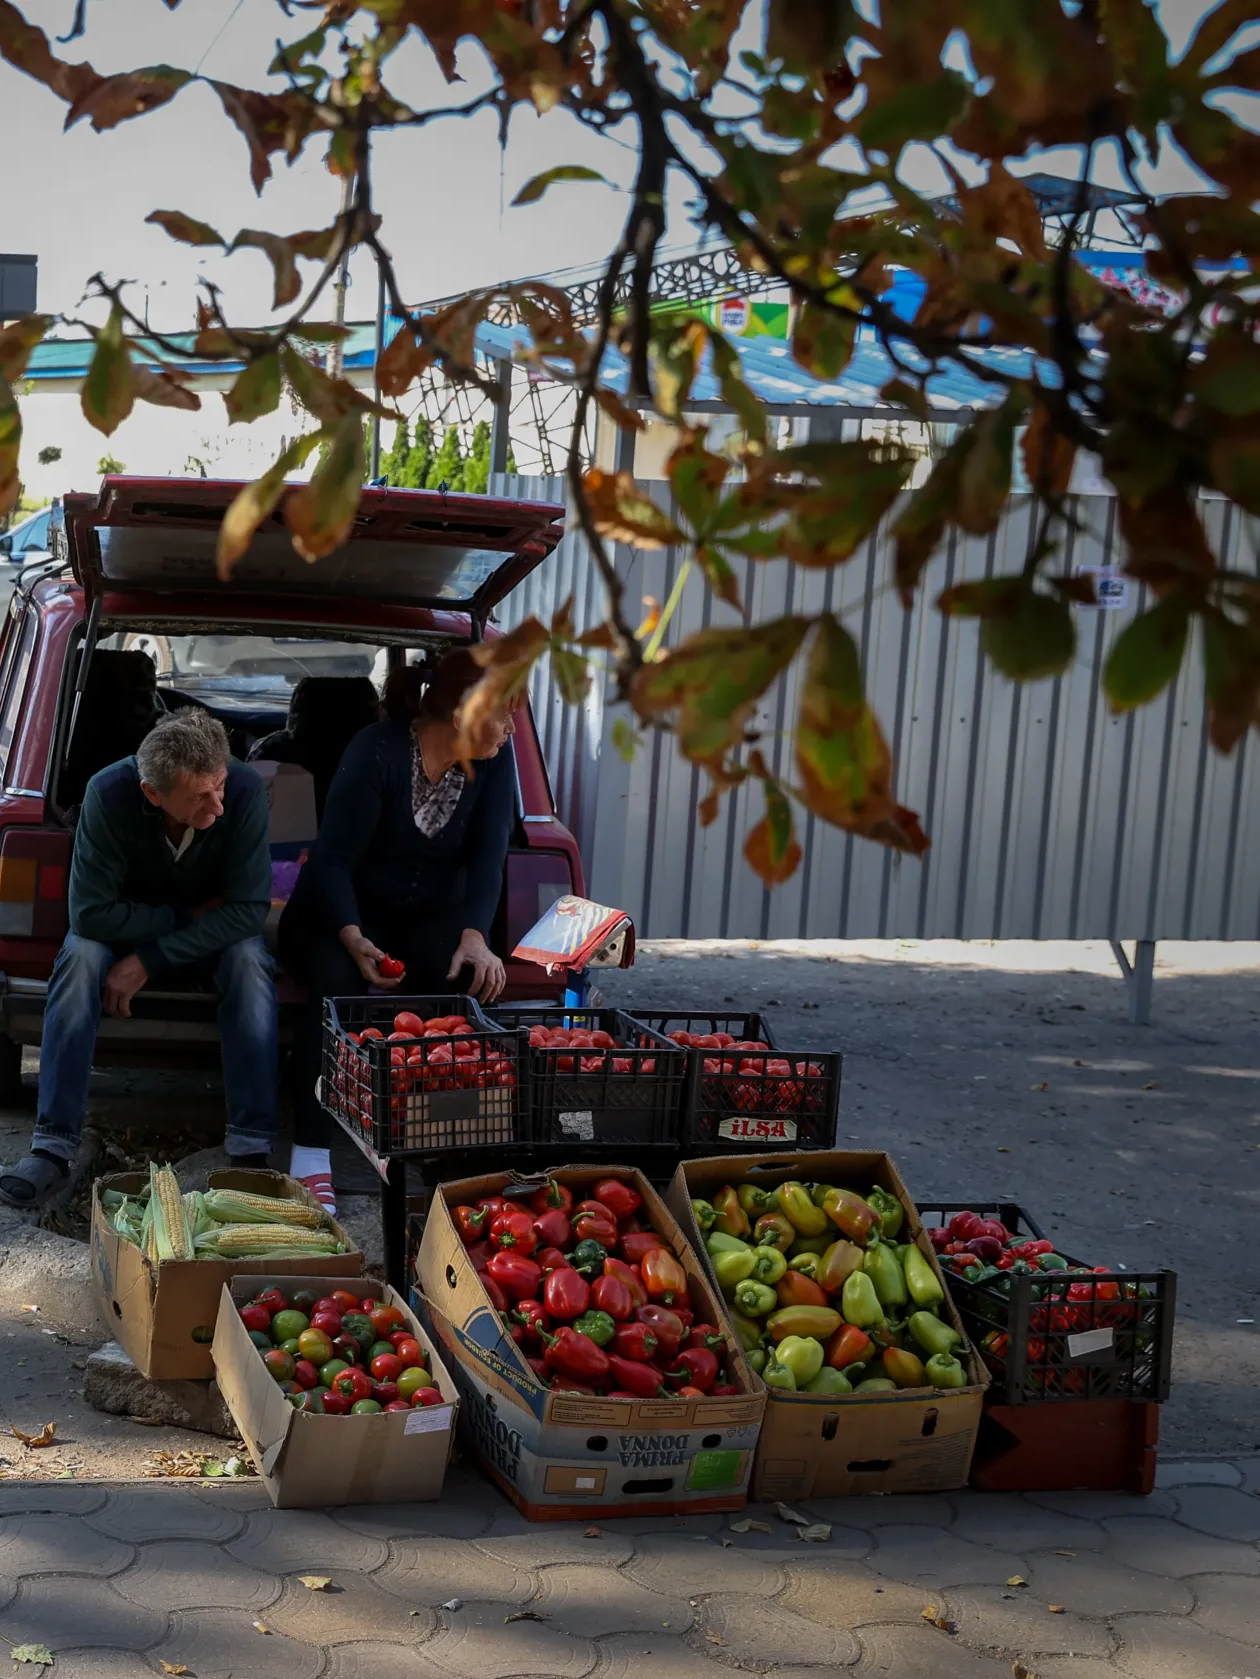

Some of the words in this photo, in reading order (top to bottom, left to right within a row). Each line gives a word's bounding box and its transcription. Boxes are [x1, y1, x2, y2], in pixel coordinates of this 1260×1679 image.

[492, 1361, 503, 1372] OF
[503, 1368, 538, 1396] PRODUCT
[617, 1434, 690, 1452] DONNA
[617, 1450, 687, 1468] PRIMA
